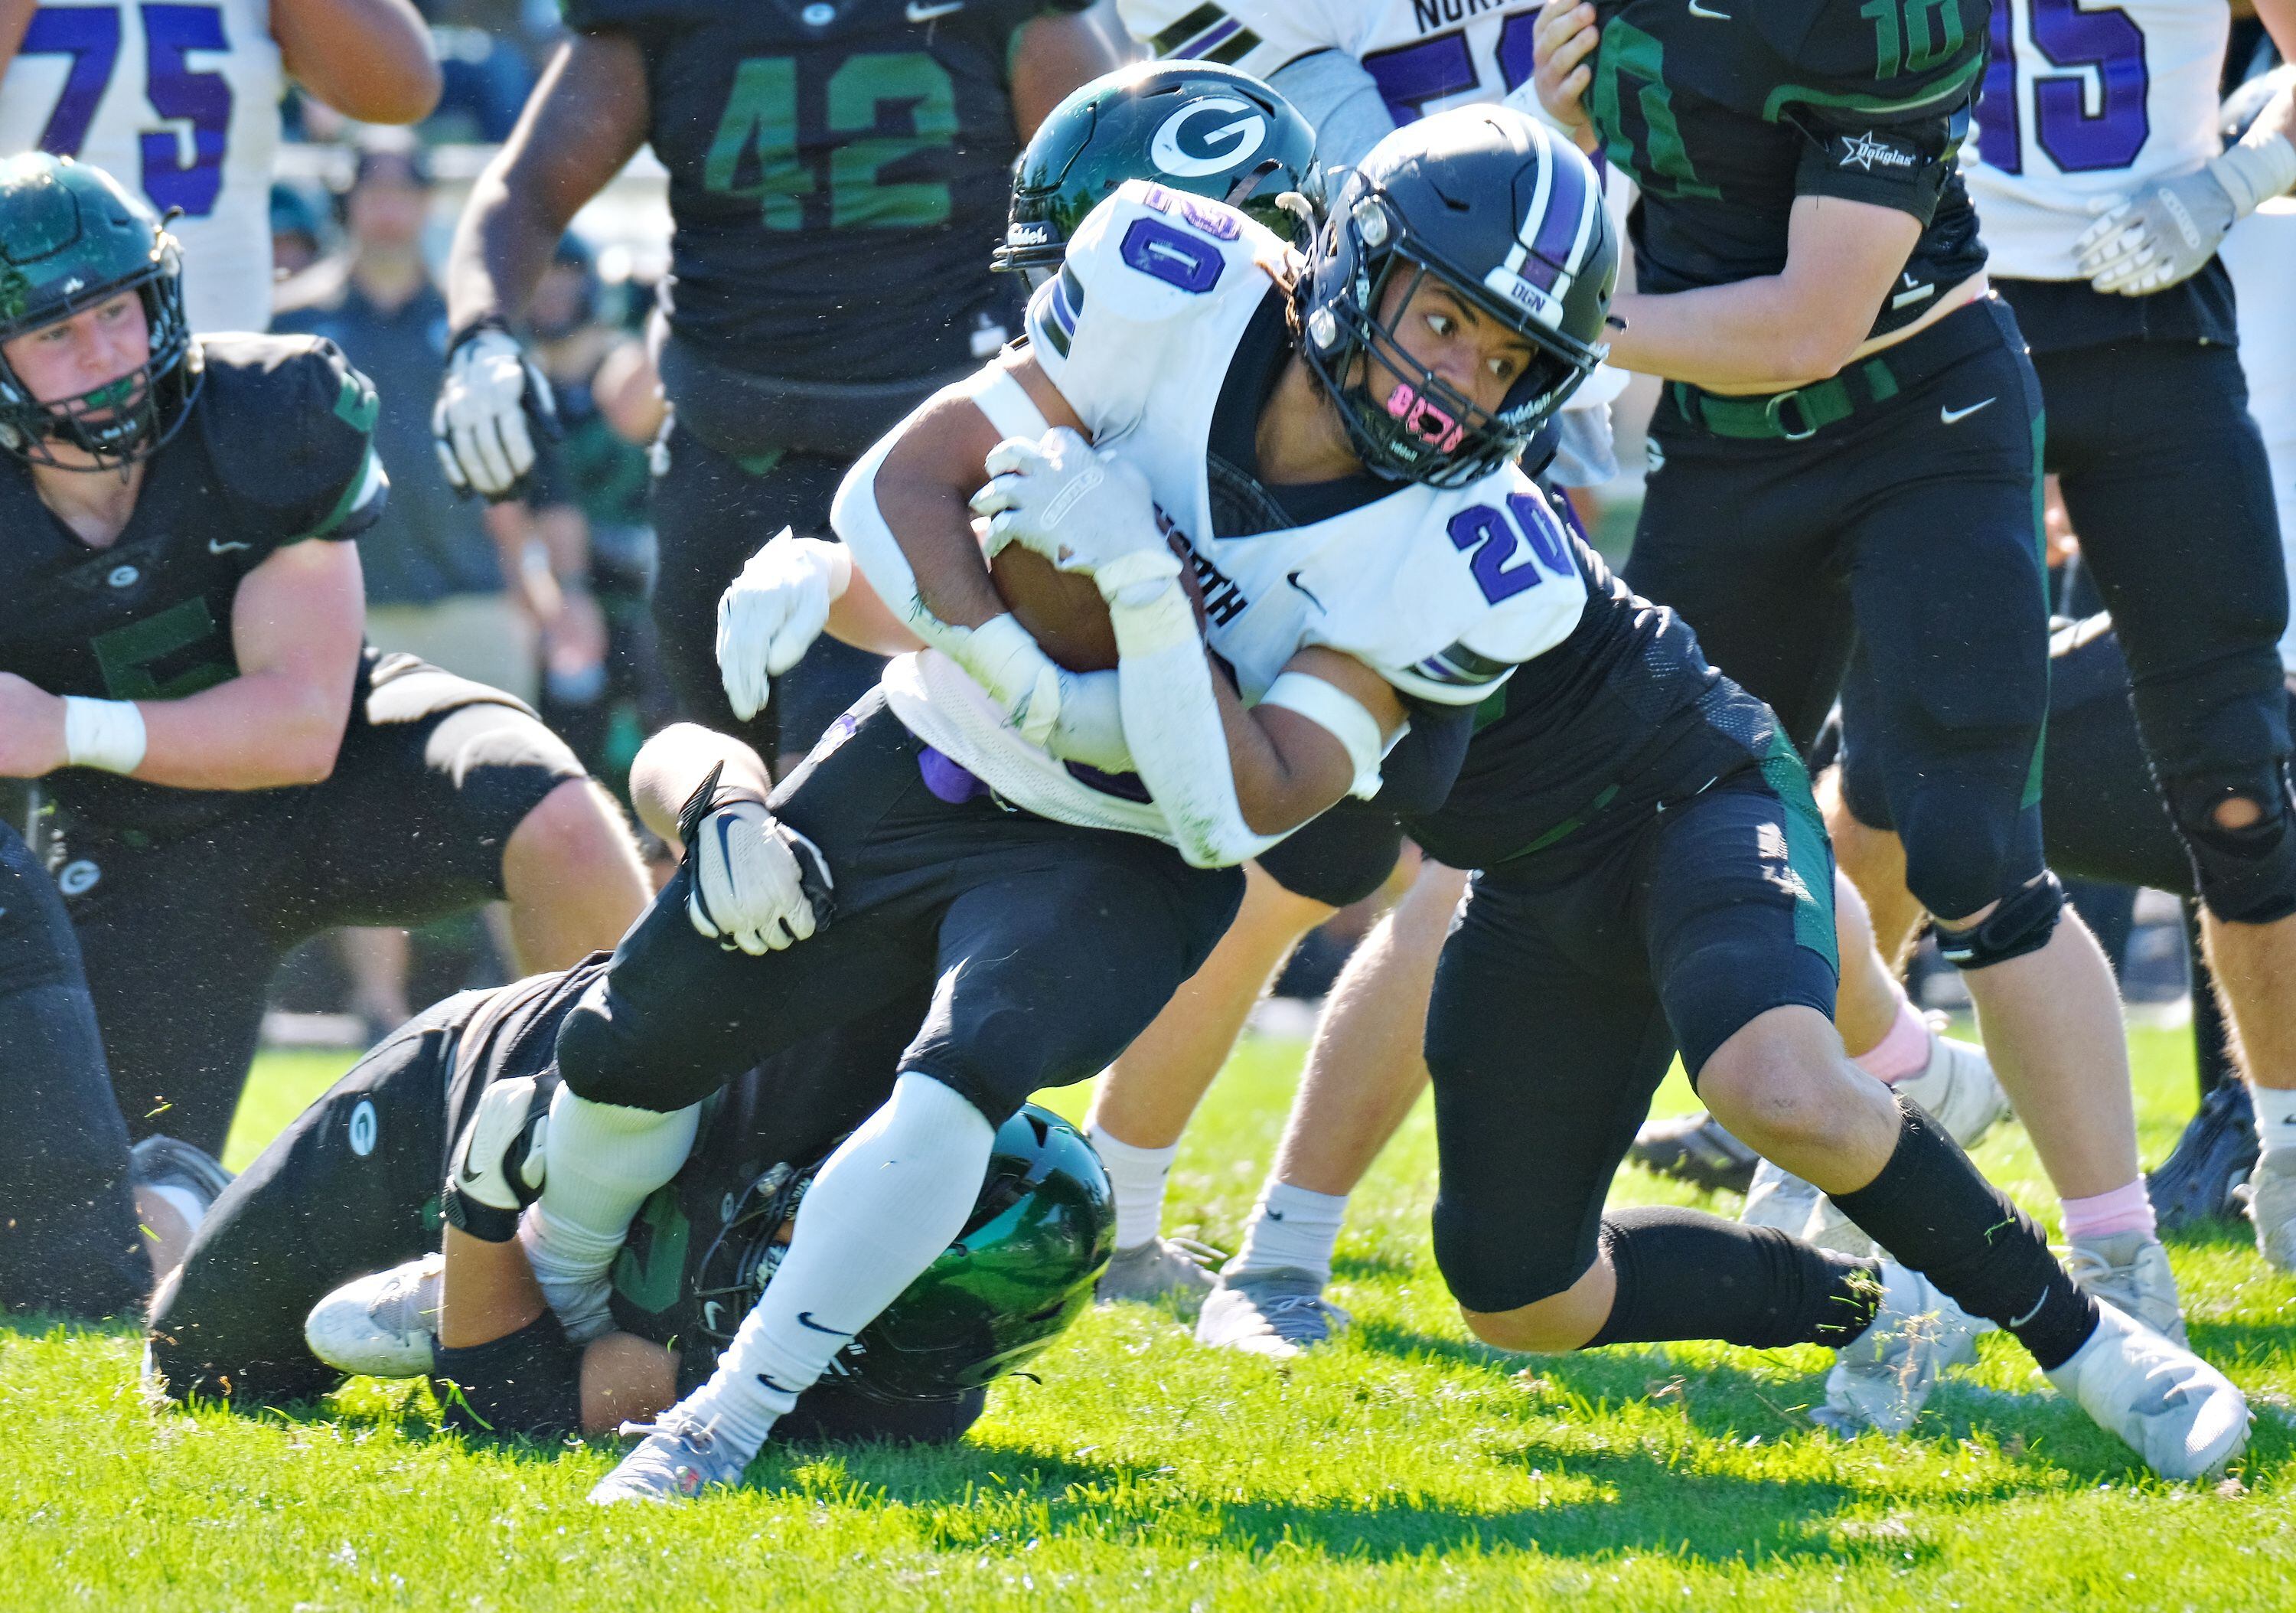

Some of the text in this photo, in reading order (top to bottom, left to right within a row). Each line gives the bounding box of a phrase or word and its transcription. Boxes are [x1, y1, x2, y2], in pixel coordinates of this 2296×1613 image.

[1861, 0, 1964, 79] 10
[18, 5, 234, 217] 75
[703, 52, 959, 231] 42
[1151, 98, 1266, 177] G
[1857, 142, 1912, 166] Douglas
[1511, 281, 1546, 313] DGN
[1903, 272, 1919, 288] L
[1446, 488, 1575, 606] 20
